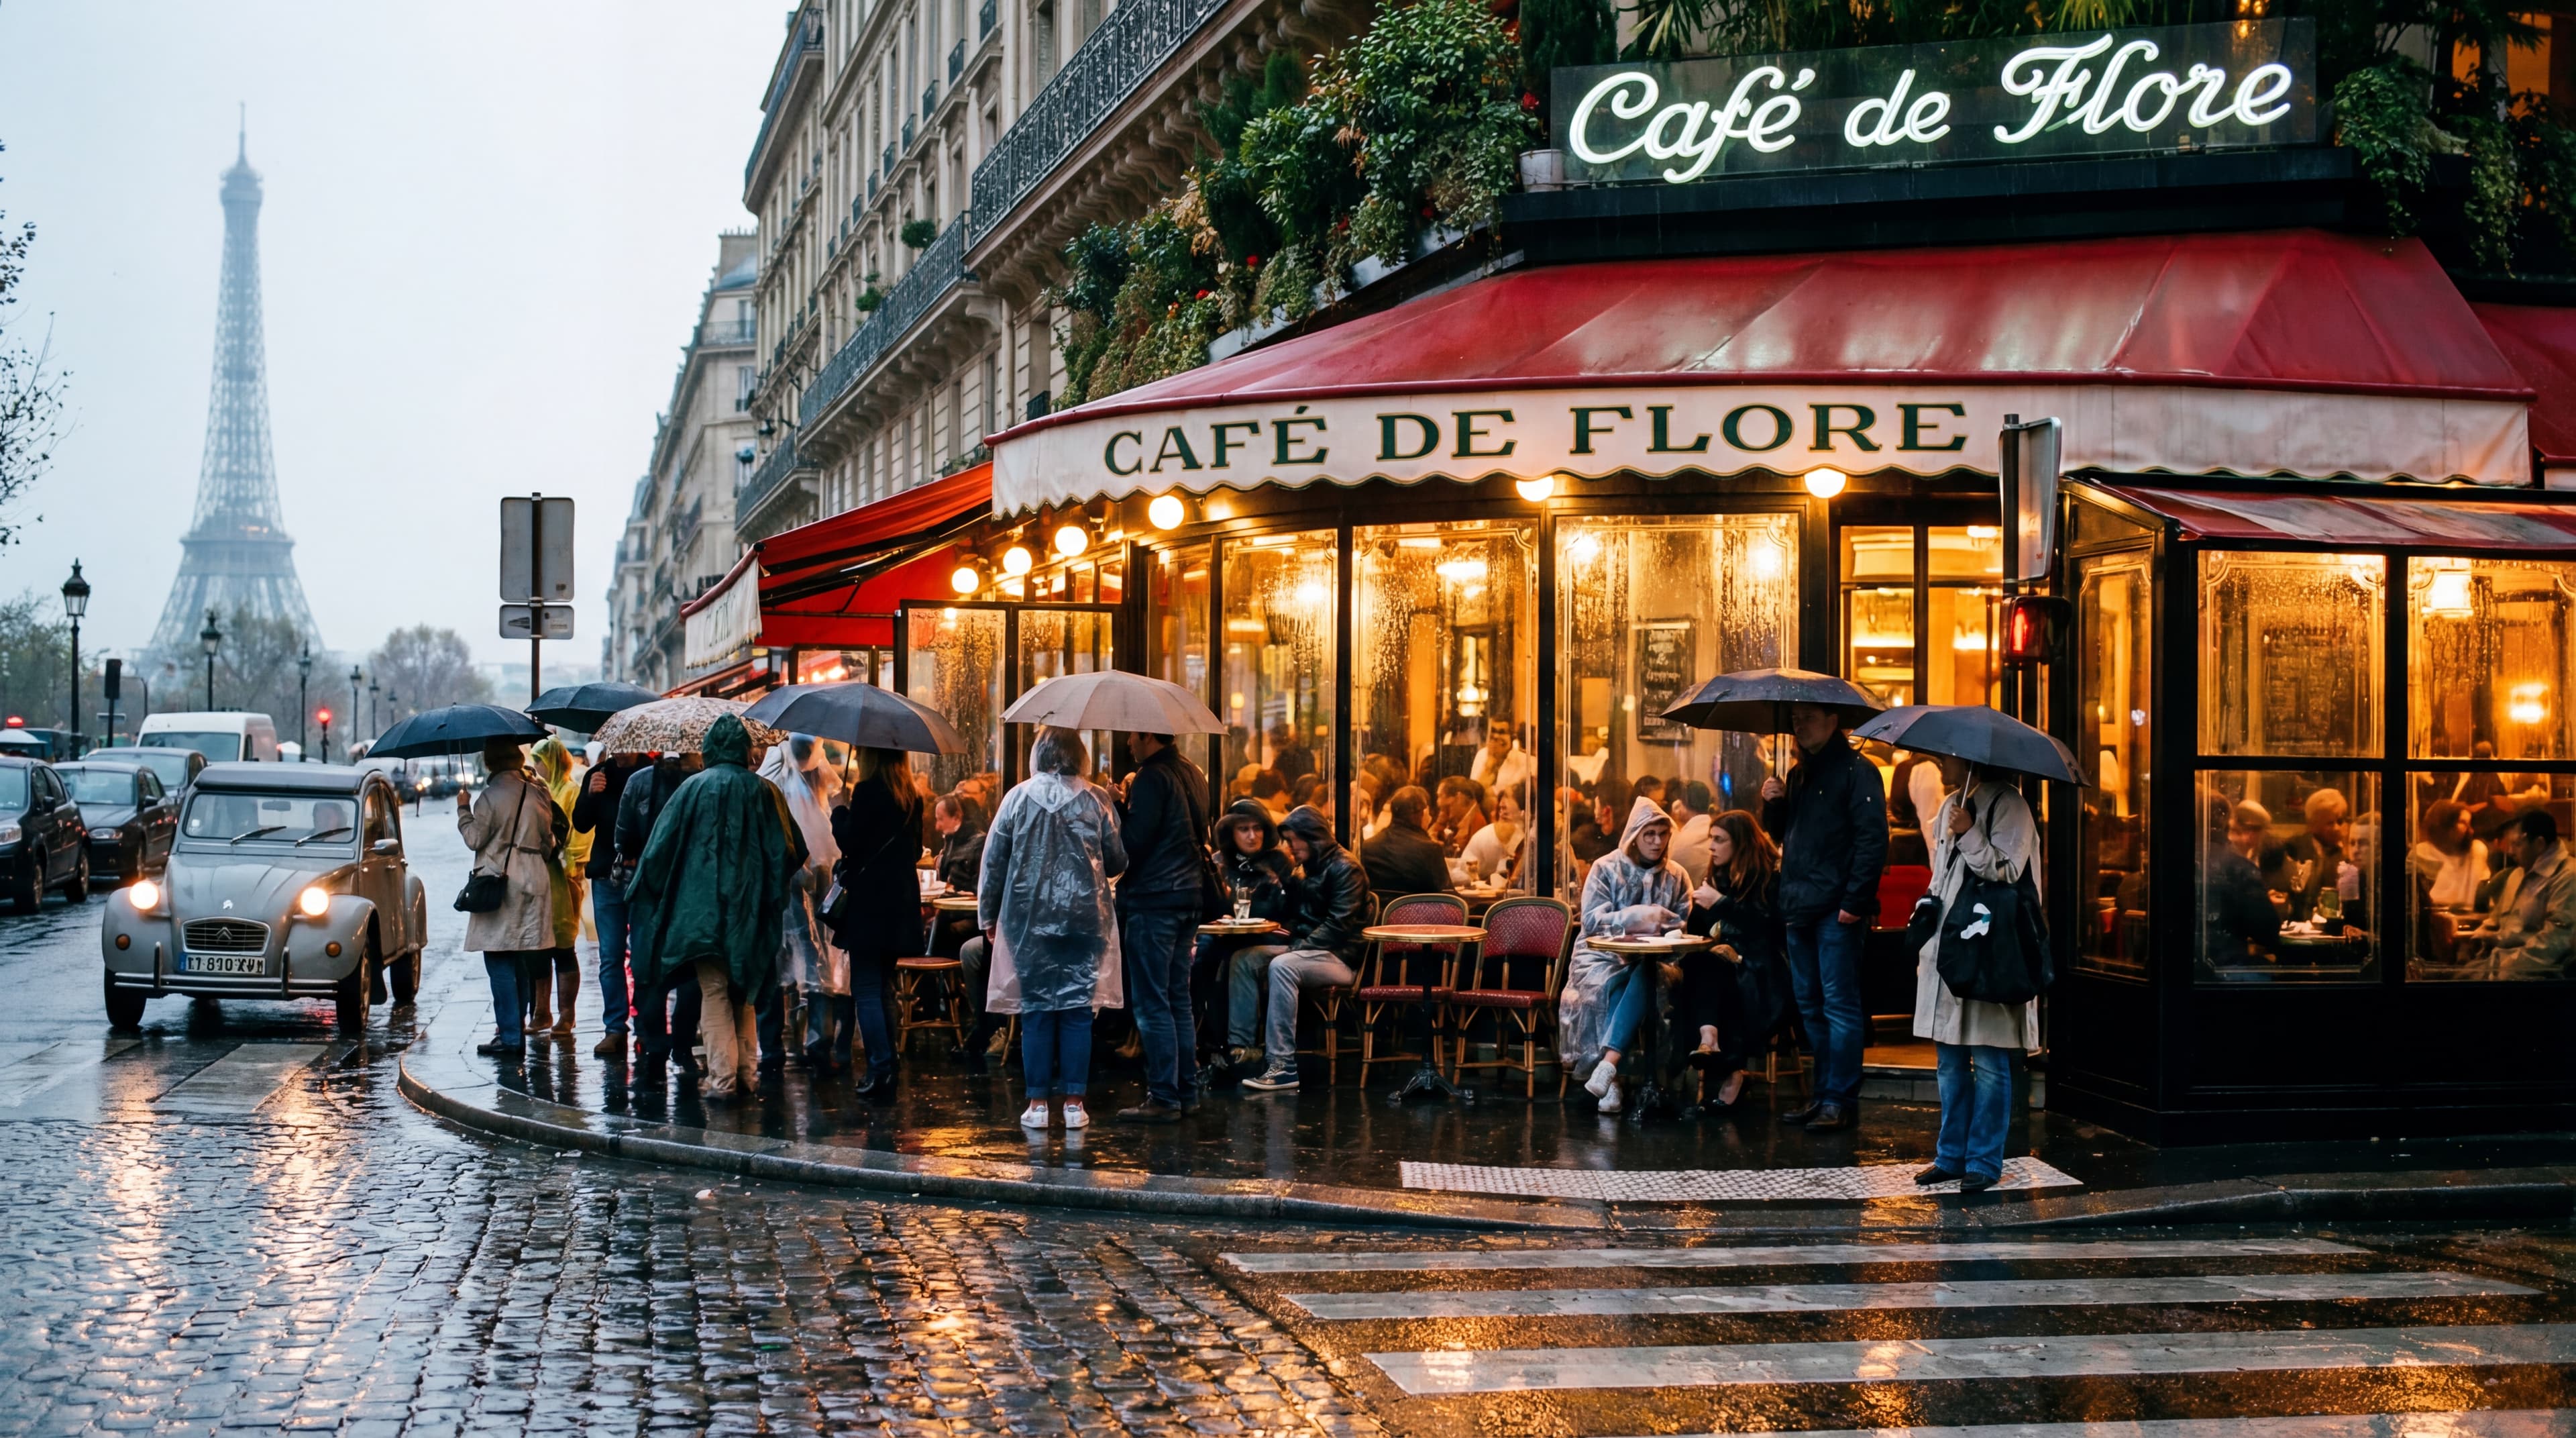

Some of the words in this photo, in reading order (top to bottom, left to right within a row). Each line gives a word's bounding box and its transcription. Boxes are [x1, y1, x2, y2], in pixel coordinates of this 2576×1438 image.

[1569, 66, 1815, 183] Café
[1844, 69, 1951, 147] de
[1994, 34, 2292, 143] Flore
[1104, 405, 1329, 476] CAFÉ
[1375, 409, 1517, 461] DE
[1568, 403, 1968, 455] FLORE
